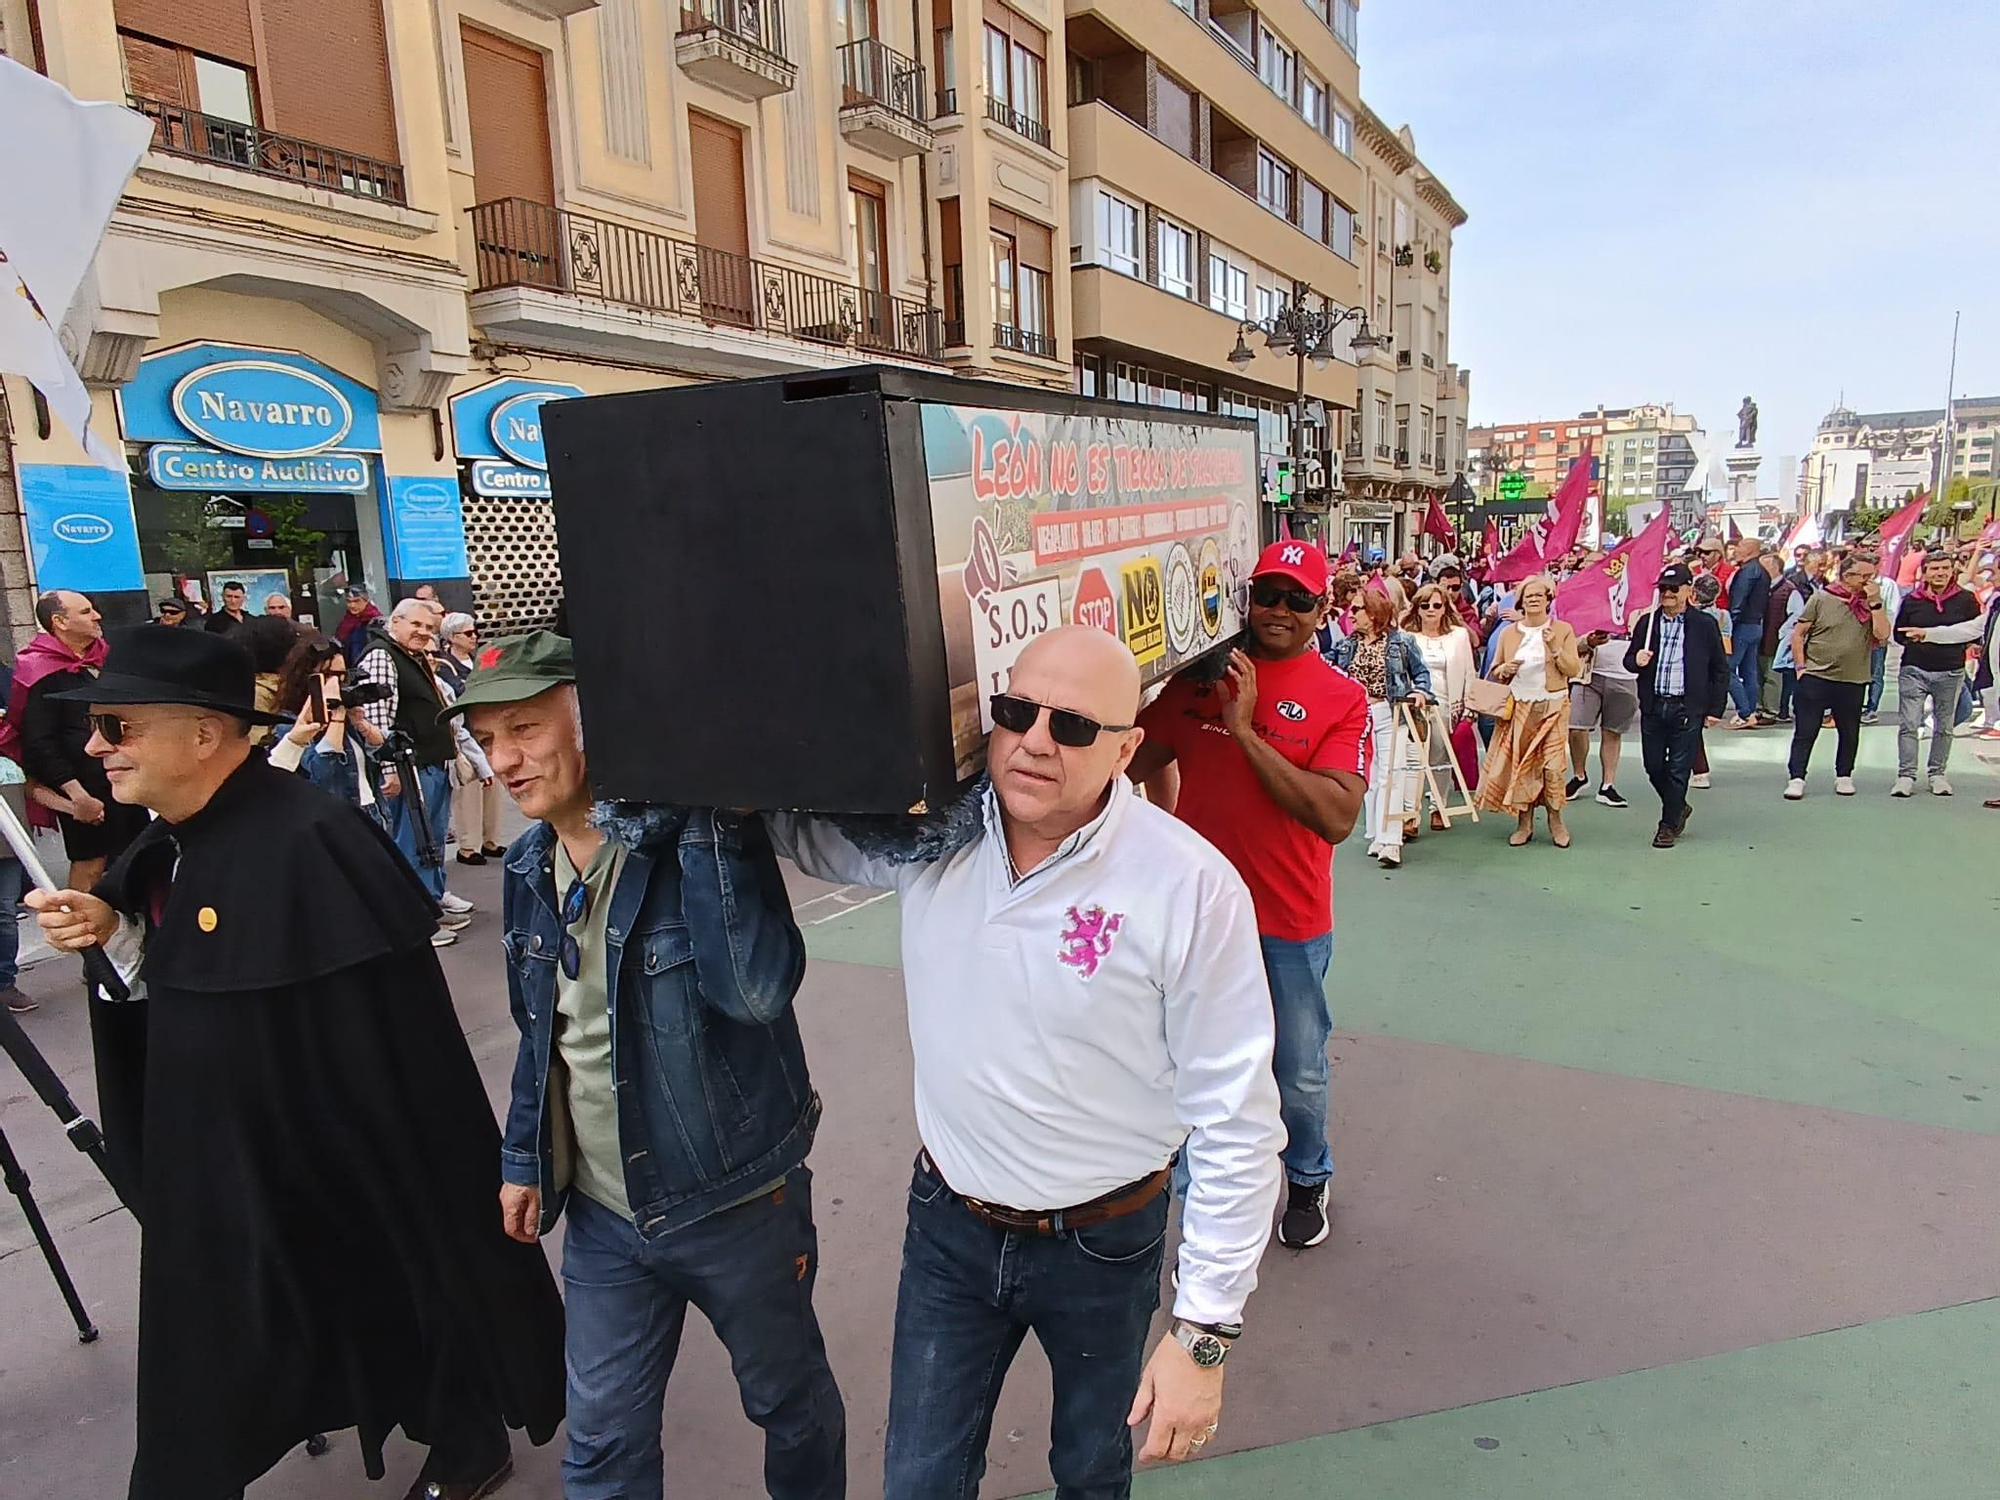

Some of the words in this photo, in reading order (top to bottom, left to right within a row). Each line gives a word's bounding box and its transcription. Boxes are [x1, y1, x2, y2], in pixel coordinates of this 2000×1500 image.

[199, 390, 332, 428] Navarro
[508, 417, 541, 442] Na
[165, 455, 255, 482] Centro
[260, 459, 361, 484] Auditivo
[972, 414, 1042, 501] LEÓN
[1050, 441, 1079, 496] NO
[1086, 443, 1110, 494] ES
[1114, 444, 1166, 492] TIERRA
[1170, 446, 1188, 489] DE
[482, 469, 541, 488] Centro
[61, 521, 107, 536] Navarro
[1125, 566, 1161, 630] NO
[1079, 597, 1112, 629] STOP
[1279, 701, 1303, 719] FILA
